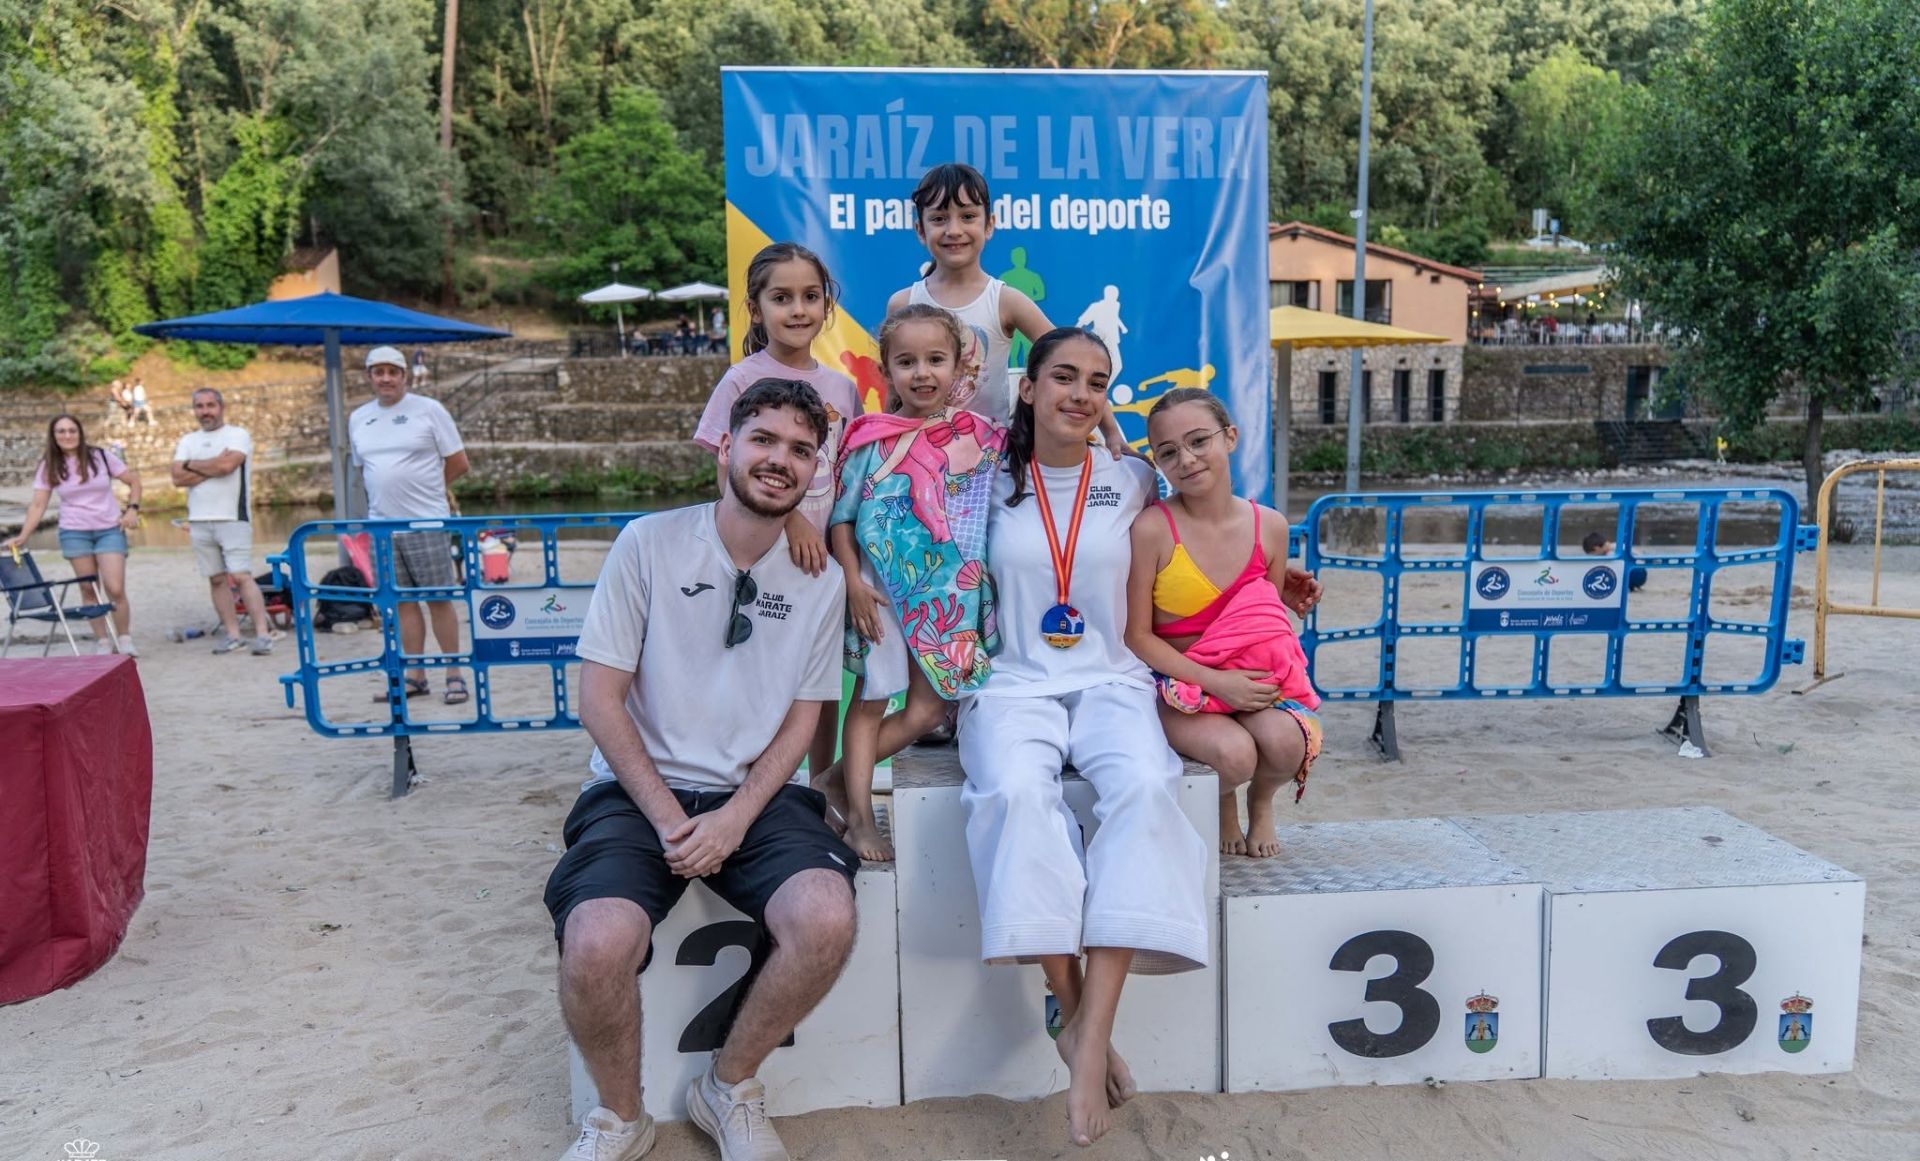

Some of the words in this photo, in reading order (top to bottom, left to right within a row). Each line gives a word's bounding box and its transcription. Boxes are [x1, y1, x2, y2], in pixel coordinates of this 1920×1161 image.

[745, 98, 933, 179] JARAÍZ
[954, 115, 1017, 179] DE
[1037, 116, 1100, 180] LA
[1117, 116, 1249, 180] VERA
[829, 194, 854, 229] El
[993, 194, 1041, 229] del
[1050, 194, 1171, 235] deporte
[1086, 493, 1121, 501] ARATE
[756, 598, 792, 612] KARATE
[762, 592, 784, 602] CLUB
[675, 920, 795, 1053] 2
[1328, 930, 1441, 1058] 3
[1647, 930, 1758, 1056] 3
